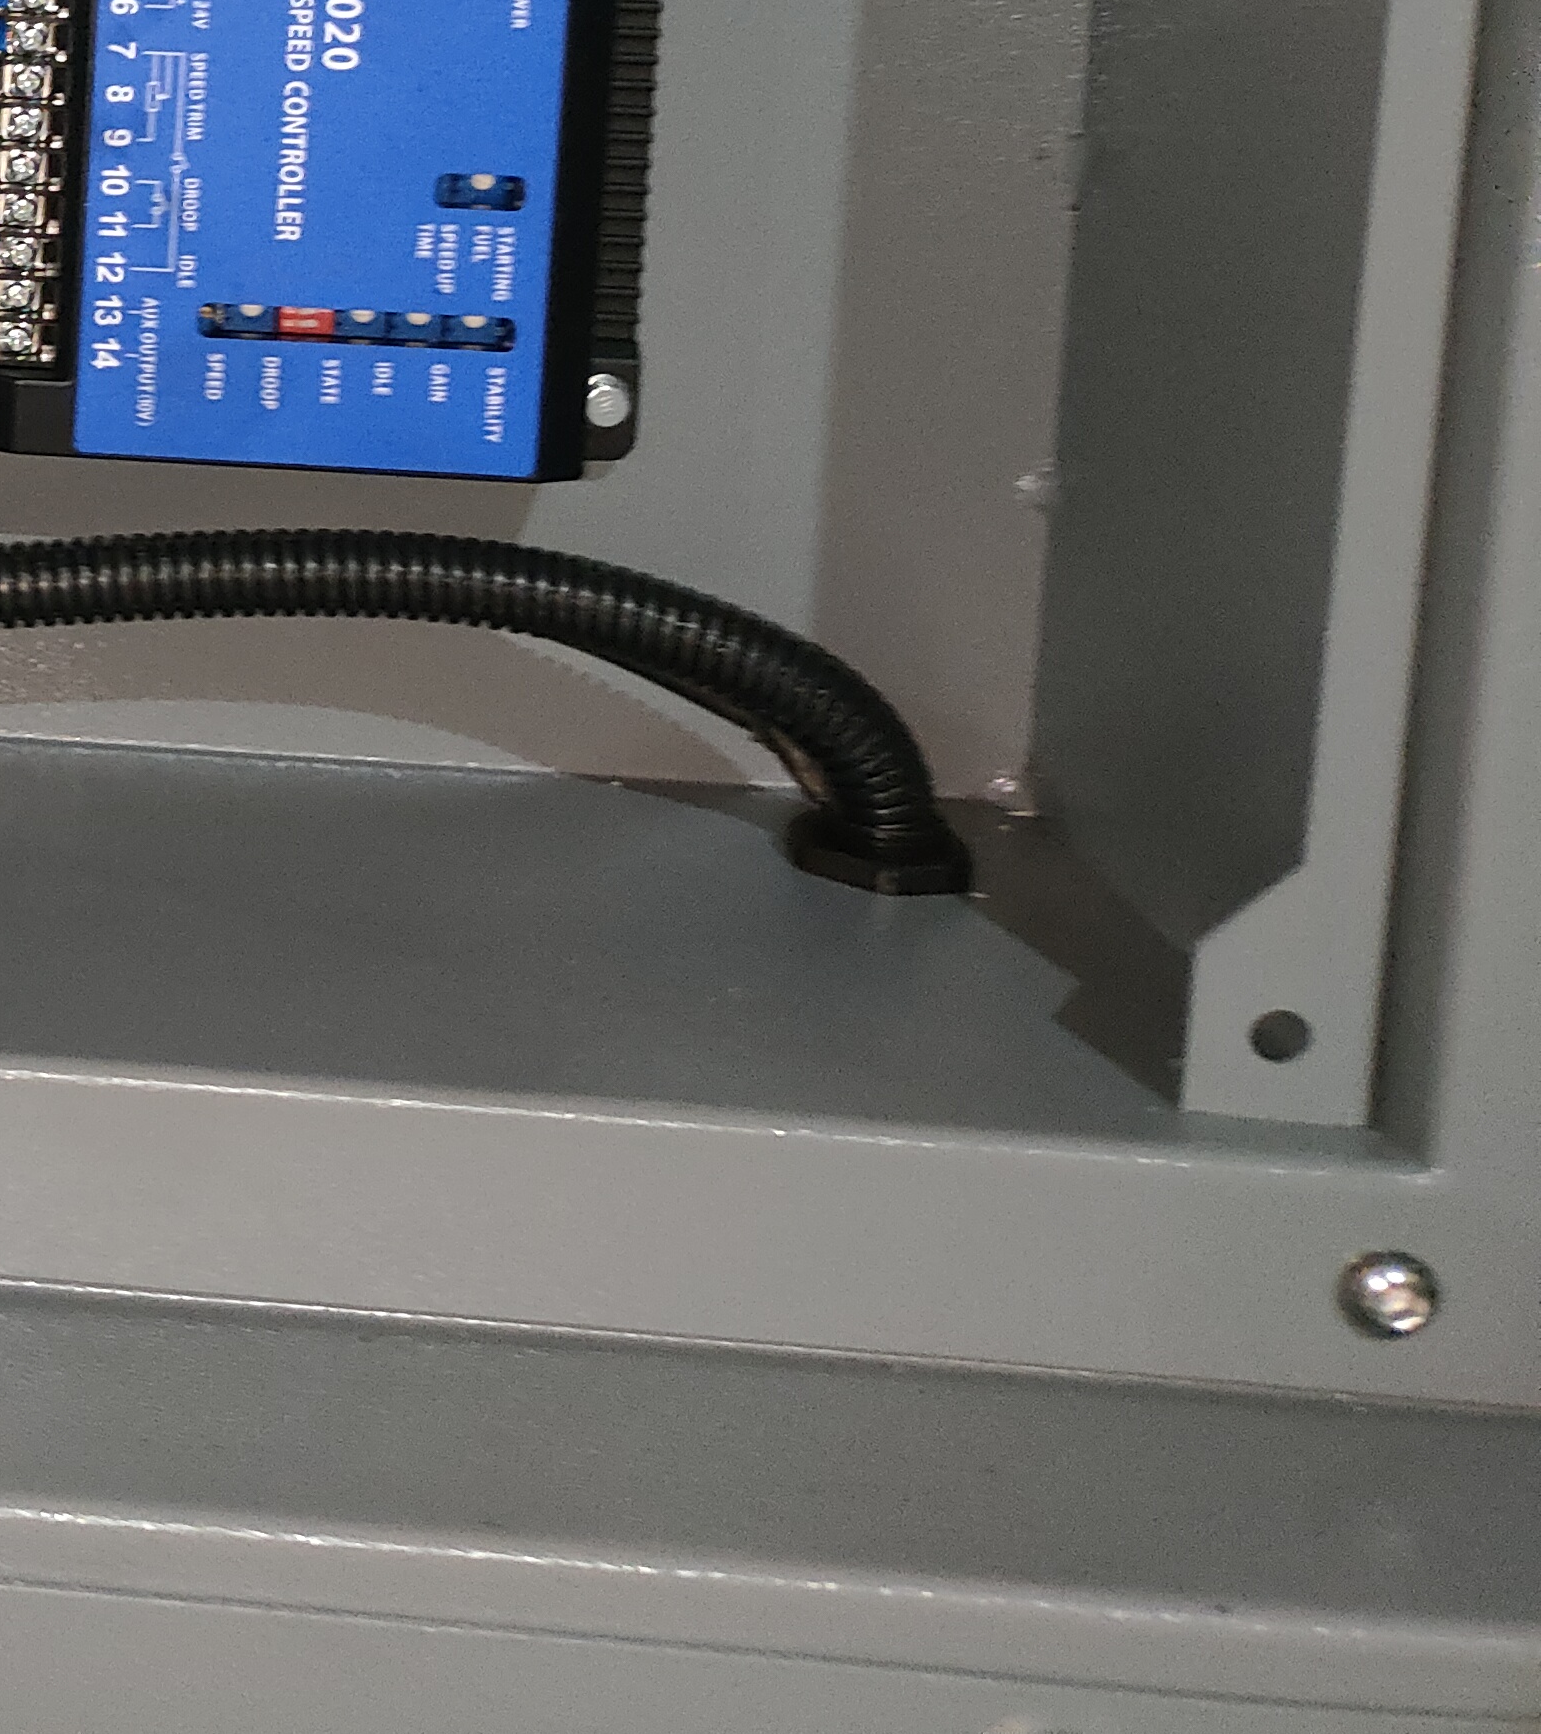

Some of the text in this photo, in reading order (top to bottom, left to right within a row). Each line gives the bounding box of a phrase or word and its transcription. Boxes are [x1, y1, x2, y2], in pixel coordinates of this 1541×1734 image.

[108, 42, 136, 59] 7
[106, 85, 134, 102] 8
[187, 54, 207, 140] SPEED TRIM
[104, 129, 132, 146] 9
[275, 81, 309, 240] CONTROLLER
[101, 165, 131, 195] 10
[183, 178, 200, 231] DROOP
[99, 212, 127, 236] 11
[416, 224, 435, 257] TIME
[436, 225, 458, 293] SPEED UP
[472, 226, 492, 261] FUEL
[97, 252, 126, 282] 12
[178, 256, 195, 287] IDLE
[491, 227, 515, 301] STARTING
[94, 295, 123, 325] 13
[141, 298, 159, 328] AUX
[92, 338, 121, 368] 14
[206, 354, 224, 399] SPEED
[261, 357, 280, 409] DROOP
[321, 360, 340, 403] STATE
[373, 363, 392, 394] IDLE
[429, 364, 449, 401] GAIN
[485, 368, 505, 442] STABILITY
